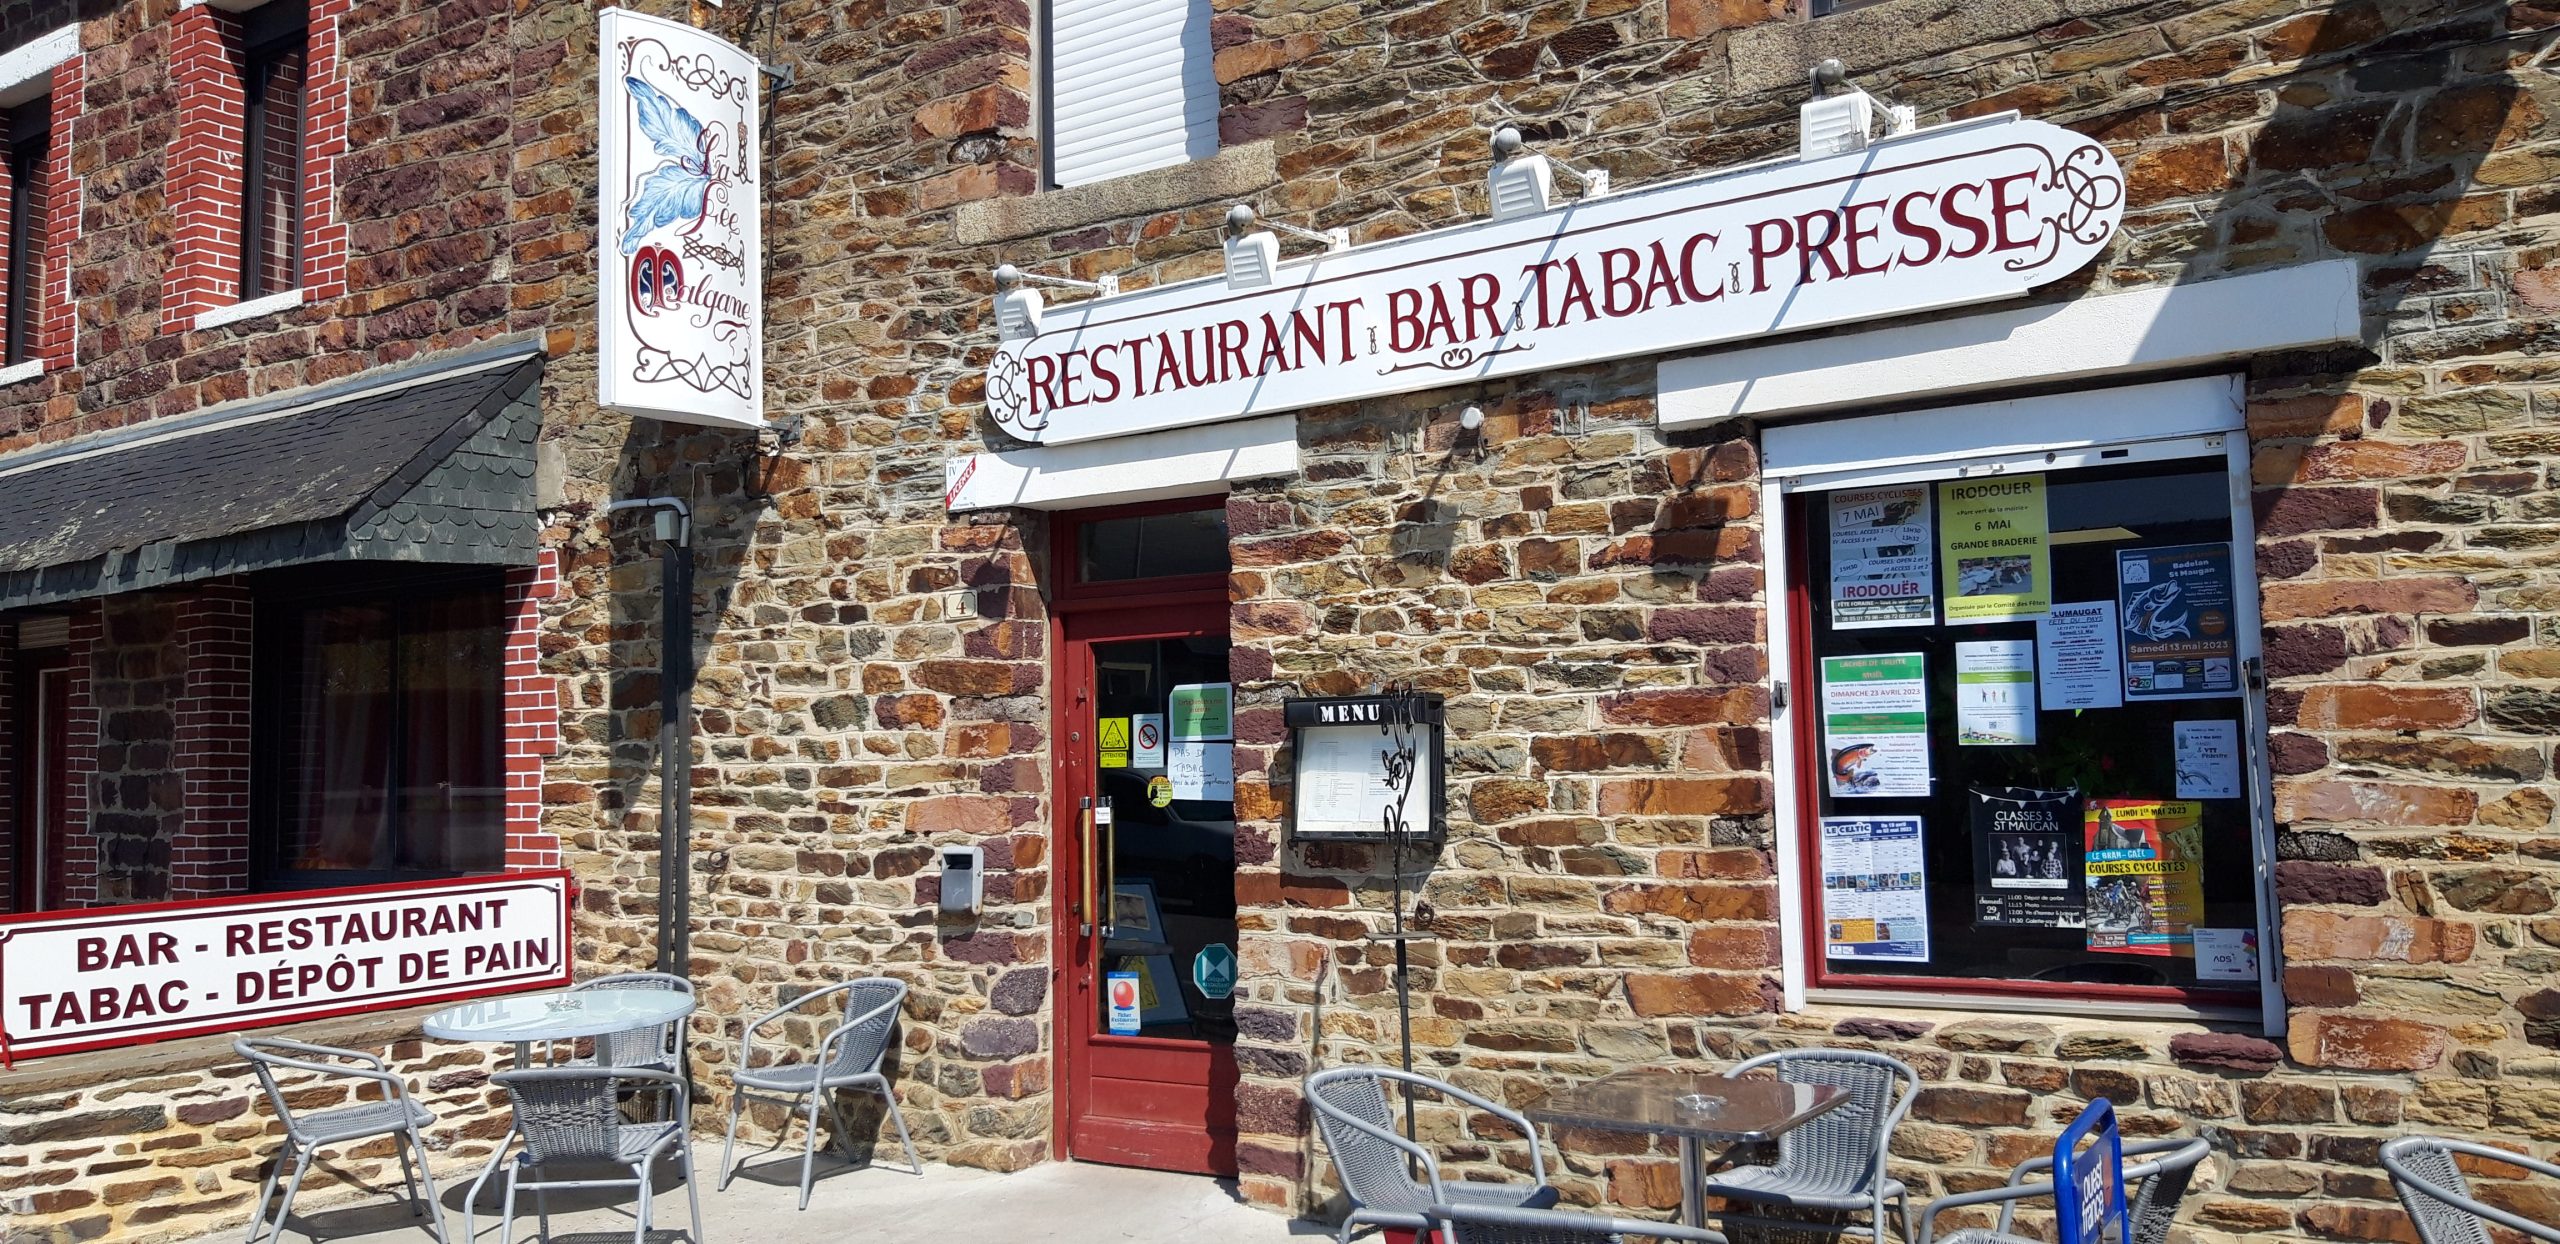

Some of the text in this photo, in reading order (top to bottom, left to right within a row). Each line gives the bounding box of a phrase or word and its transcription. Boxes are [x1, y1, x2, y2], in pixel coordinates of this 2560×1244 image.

[681, 120, 732, 188] La
[1024, 165, 2047, 416] RESTAURANT BAR TABAC PRESSE
[949, 461, 975, 503] LICENCE
[1834, 488, 1923, 503] COURSES CYCLISTES
[1951, 482, 2032, 500] IRODOUER
[1843, 505, 1879, 522] 7 MAI
[1974, 520, 2011, 531] 6 MAI
[1950, 537, 2038, 550] GRANDE BRADERIE
[2180, 567, 2215, 577] Maugan
[1843, 580, 1919, 598] IRODOUËR
[956, 595, 966, 614] 4
[2051, 608, 2103, 618] LUMAUGAT
[2130, 640, 2229, 654] Samedi 13 mai 2023
[1320, 704, 1381, 723] MENU
[1174, 747, 1191, 757] PAS
[1995, 811, 2052, 821] CLASSES 3
[2116, 808, 2138, 817] LUNDI
[2151, 807, 2165, 816] MAI
[2168, 806, 2186, 815] 2023
[1840, 823, 1870, 834] CELTIC
[1994, 821, 2059, 831] ST MAUGAN
[2092, 852, 2100, 860] LE
[2089, 861, 2186, 874] COURSES CYCLISTES
[1986, 906, 1997, 914] 29
[77, 931, 180, 973] BAR
[226, 899, 509, 958] RESTAURANT
[20, 979, 190, 1031] TABAC
[236, 953, 378, 1006] DÉPÔT
[399, 951, 451, 983] DE
[464, 937, 549, 976] PAIN
[2083, 1154, 2103, 1203] ouest
[2081, 1189, 2104, 1238] france
